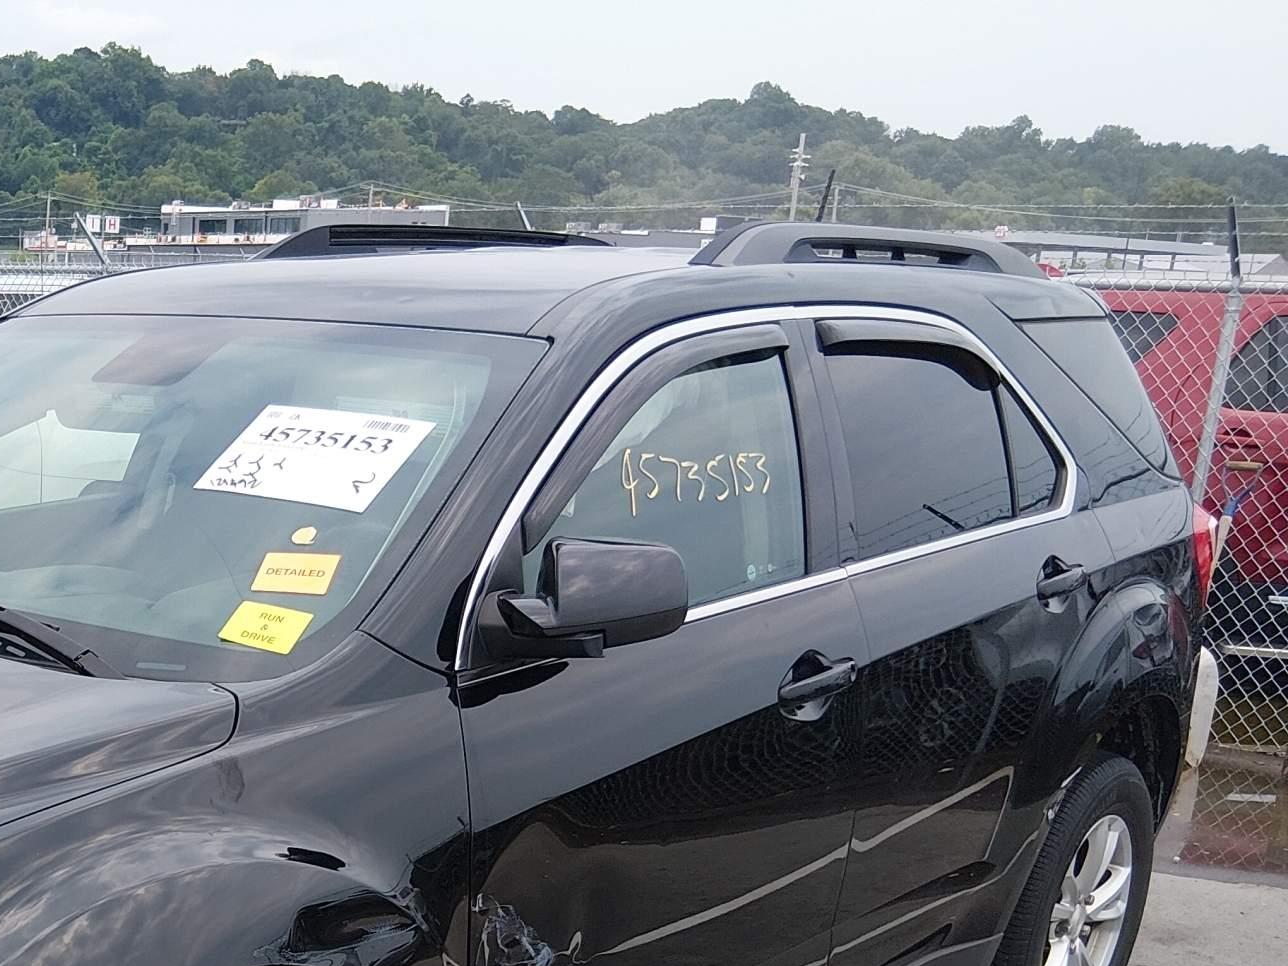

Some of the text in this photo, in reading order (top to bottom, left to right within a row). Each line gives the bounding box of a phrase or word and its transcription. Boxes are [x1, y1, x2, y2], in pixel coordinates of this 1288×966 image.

[259, 425, 394, 455] 45735153
[622, 448, 771, 517] 45735153
[265, 567, 327, 578] DETAILED
[259, 612, 285, 623] RUN
[240, 630, 276, 645] DRIVE
